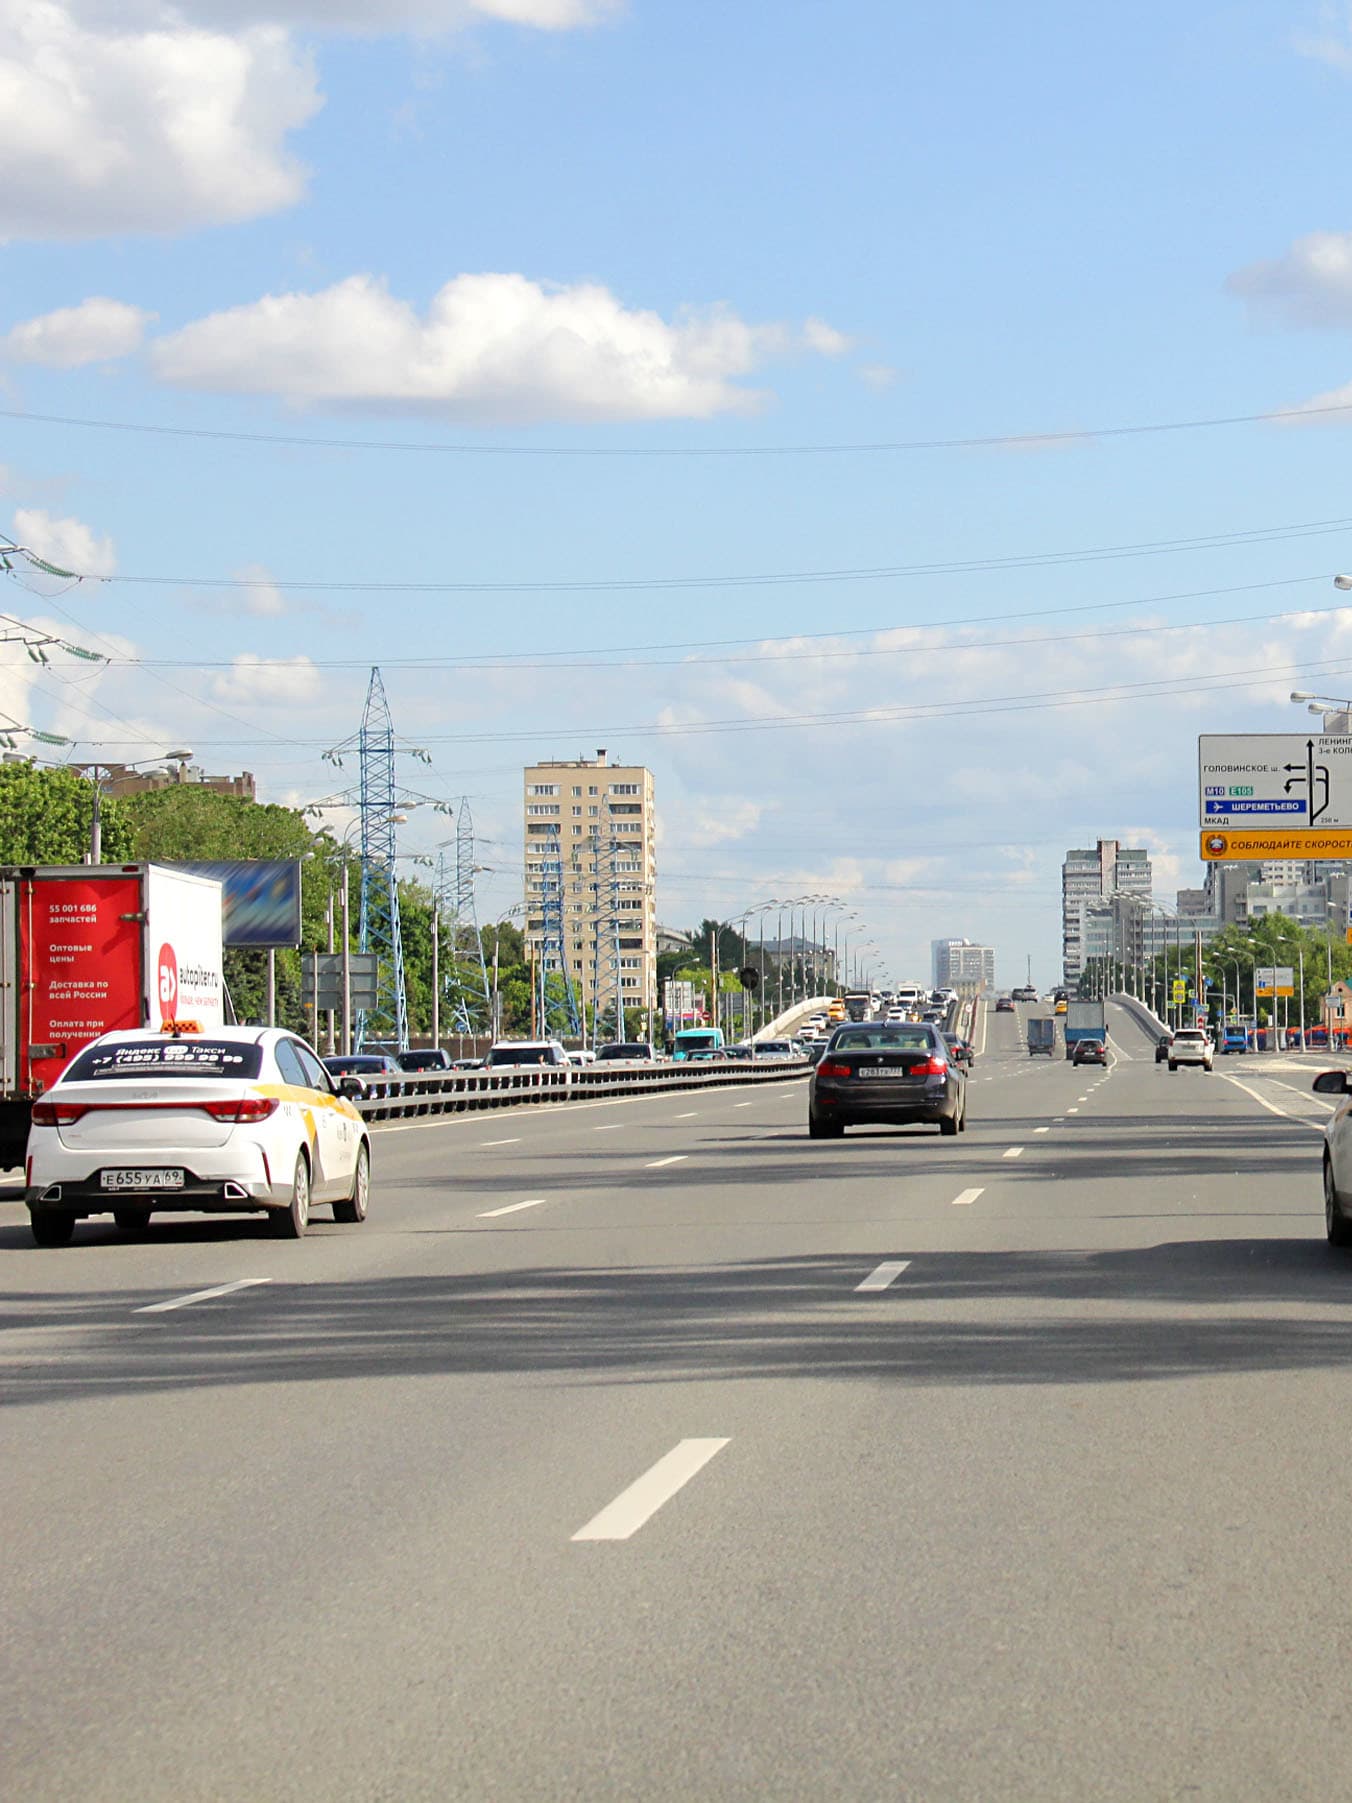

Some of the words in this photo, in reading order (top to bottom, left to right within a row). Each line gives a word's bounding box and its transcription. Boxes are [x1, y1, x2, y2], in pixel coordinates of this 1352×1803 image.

[1203, 764, 1270, 773] ГОЛОВИНСКОЕ
[1231, 802, 1299, 811] ШЕРЕМЕТЬЕВО
[1204, 816, 1230, 825] МКАД
[1231, 839, 1302, 850] СОБЛЮДАЙТЕ
[49, 904, 60, 913] 55
[62, 904, 78, 913] 001
[49, 914, 97, 924] запчастей
[49, 944, 93, 952] Оптовые
[49, 955, 75, 963] цены
[49, 980, 94, 990] Доставка
[49, 990, 71, 999] всей
[73, 991, 107, 999] России
[49, 1019, 84, 1028] Оплата
[86, 1020, 104, 1029] при
[49, 1031, 101, 1040] получении
[191, 1046, 226, 1055] Такси
